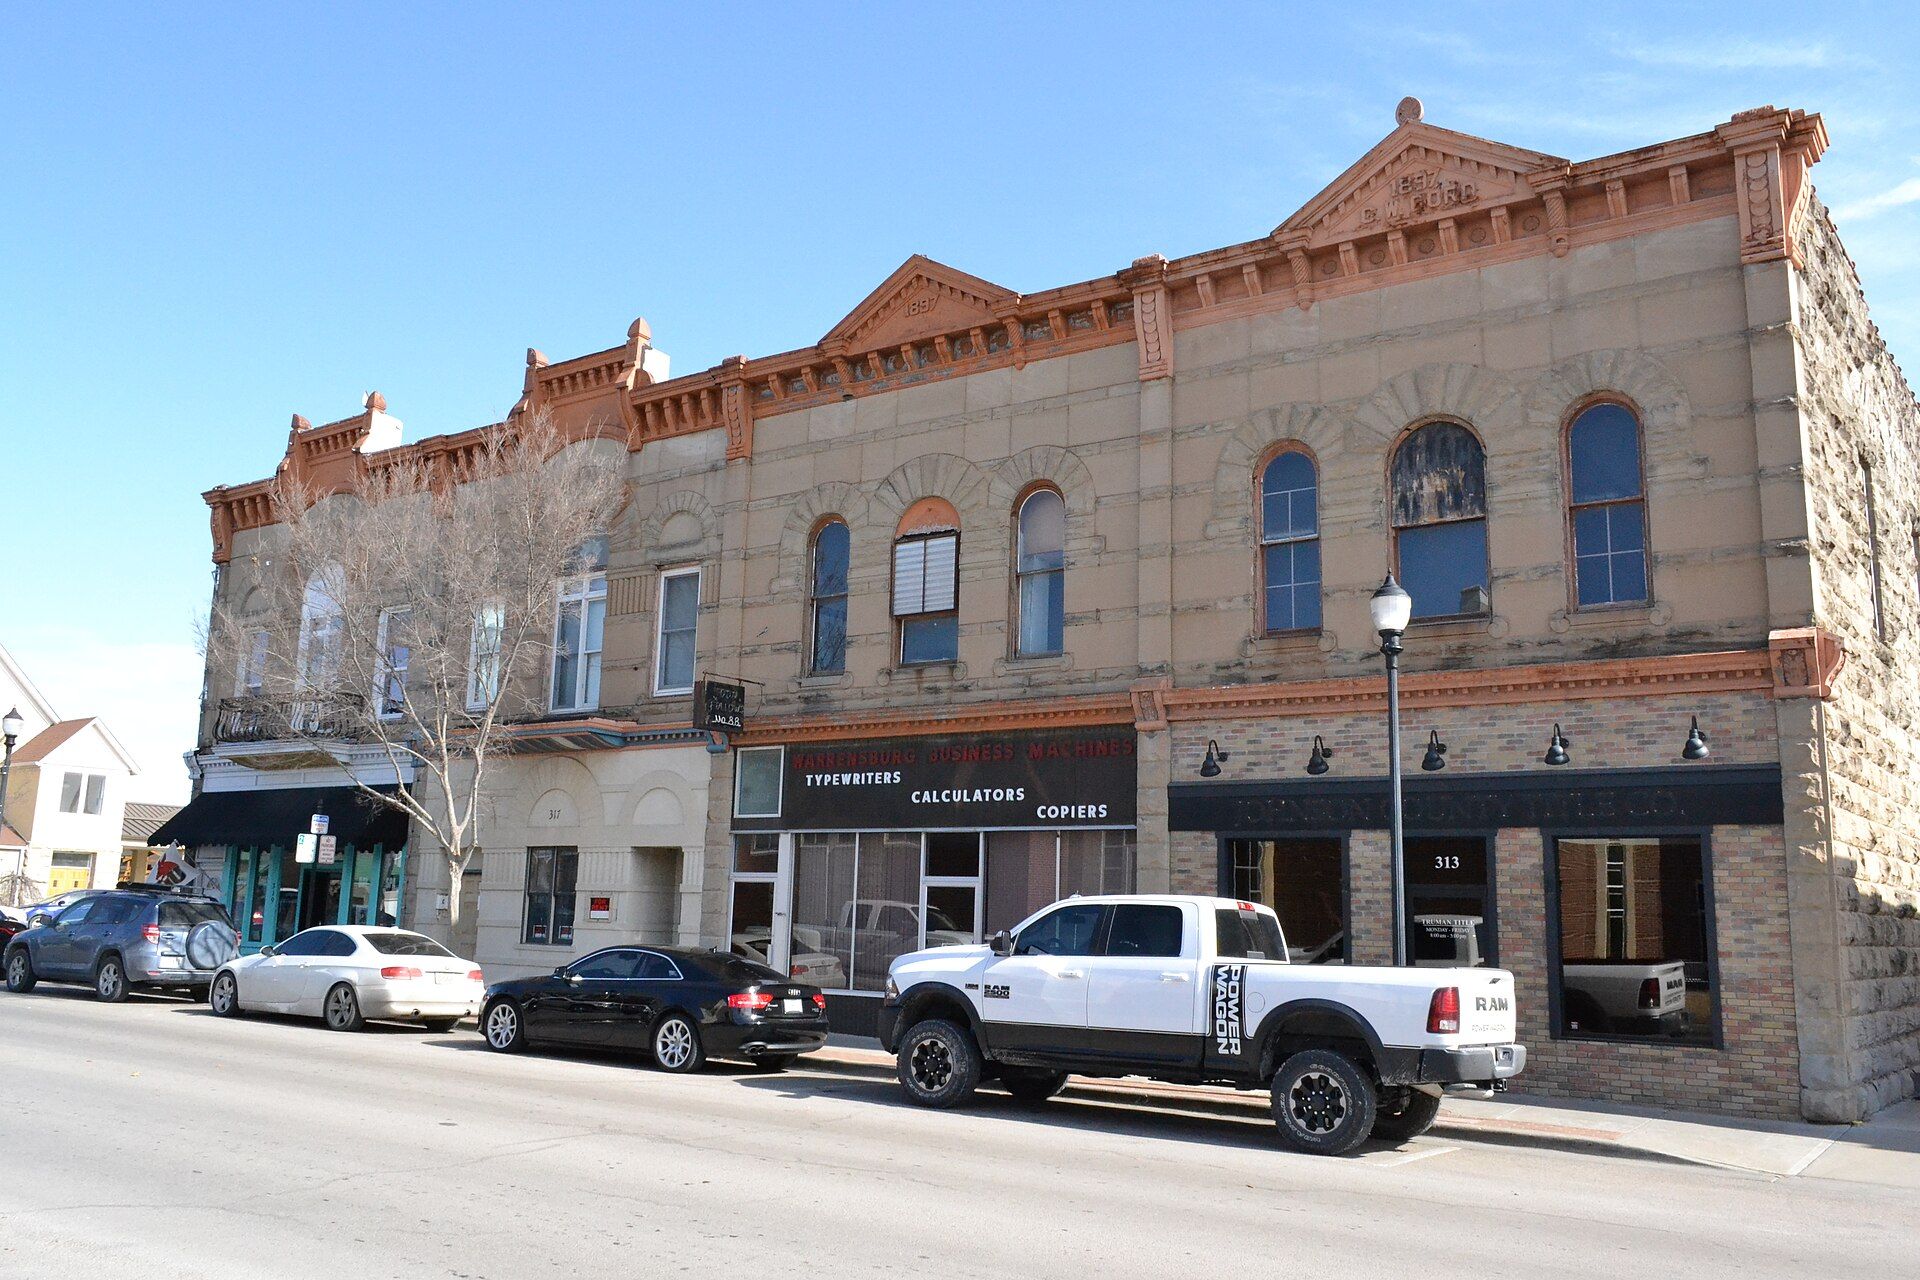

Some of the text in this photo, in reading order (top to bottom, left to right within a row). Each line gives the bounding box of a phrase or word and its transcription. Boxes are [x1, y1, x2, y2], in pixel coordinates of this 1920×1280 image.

[793, 739, 1134, 768] WARRENSBURG BUSINESS MACHINES
[806, 771, 901, 786] TYPEWRITERS
[911, 787, 1025, 803] CALCULATORS
[549, 809, 561, 820] 317
[1036, 804, 1107, 819] COPIERS
[1434, 856, 1460, 869] 313
[1216, 965, 1230, 1055] WAGON
[1228, 965, 1241, 1055] POWER
[1476, 997, 1508, 1011] RAM
